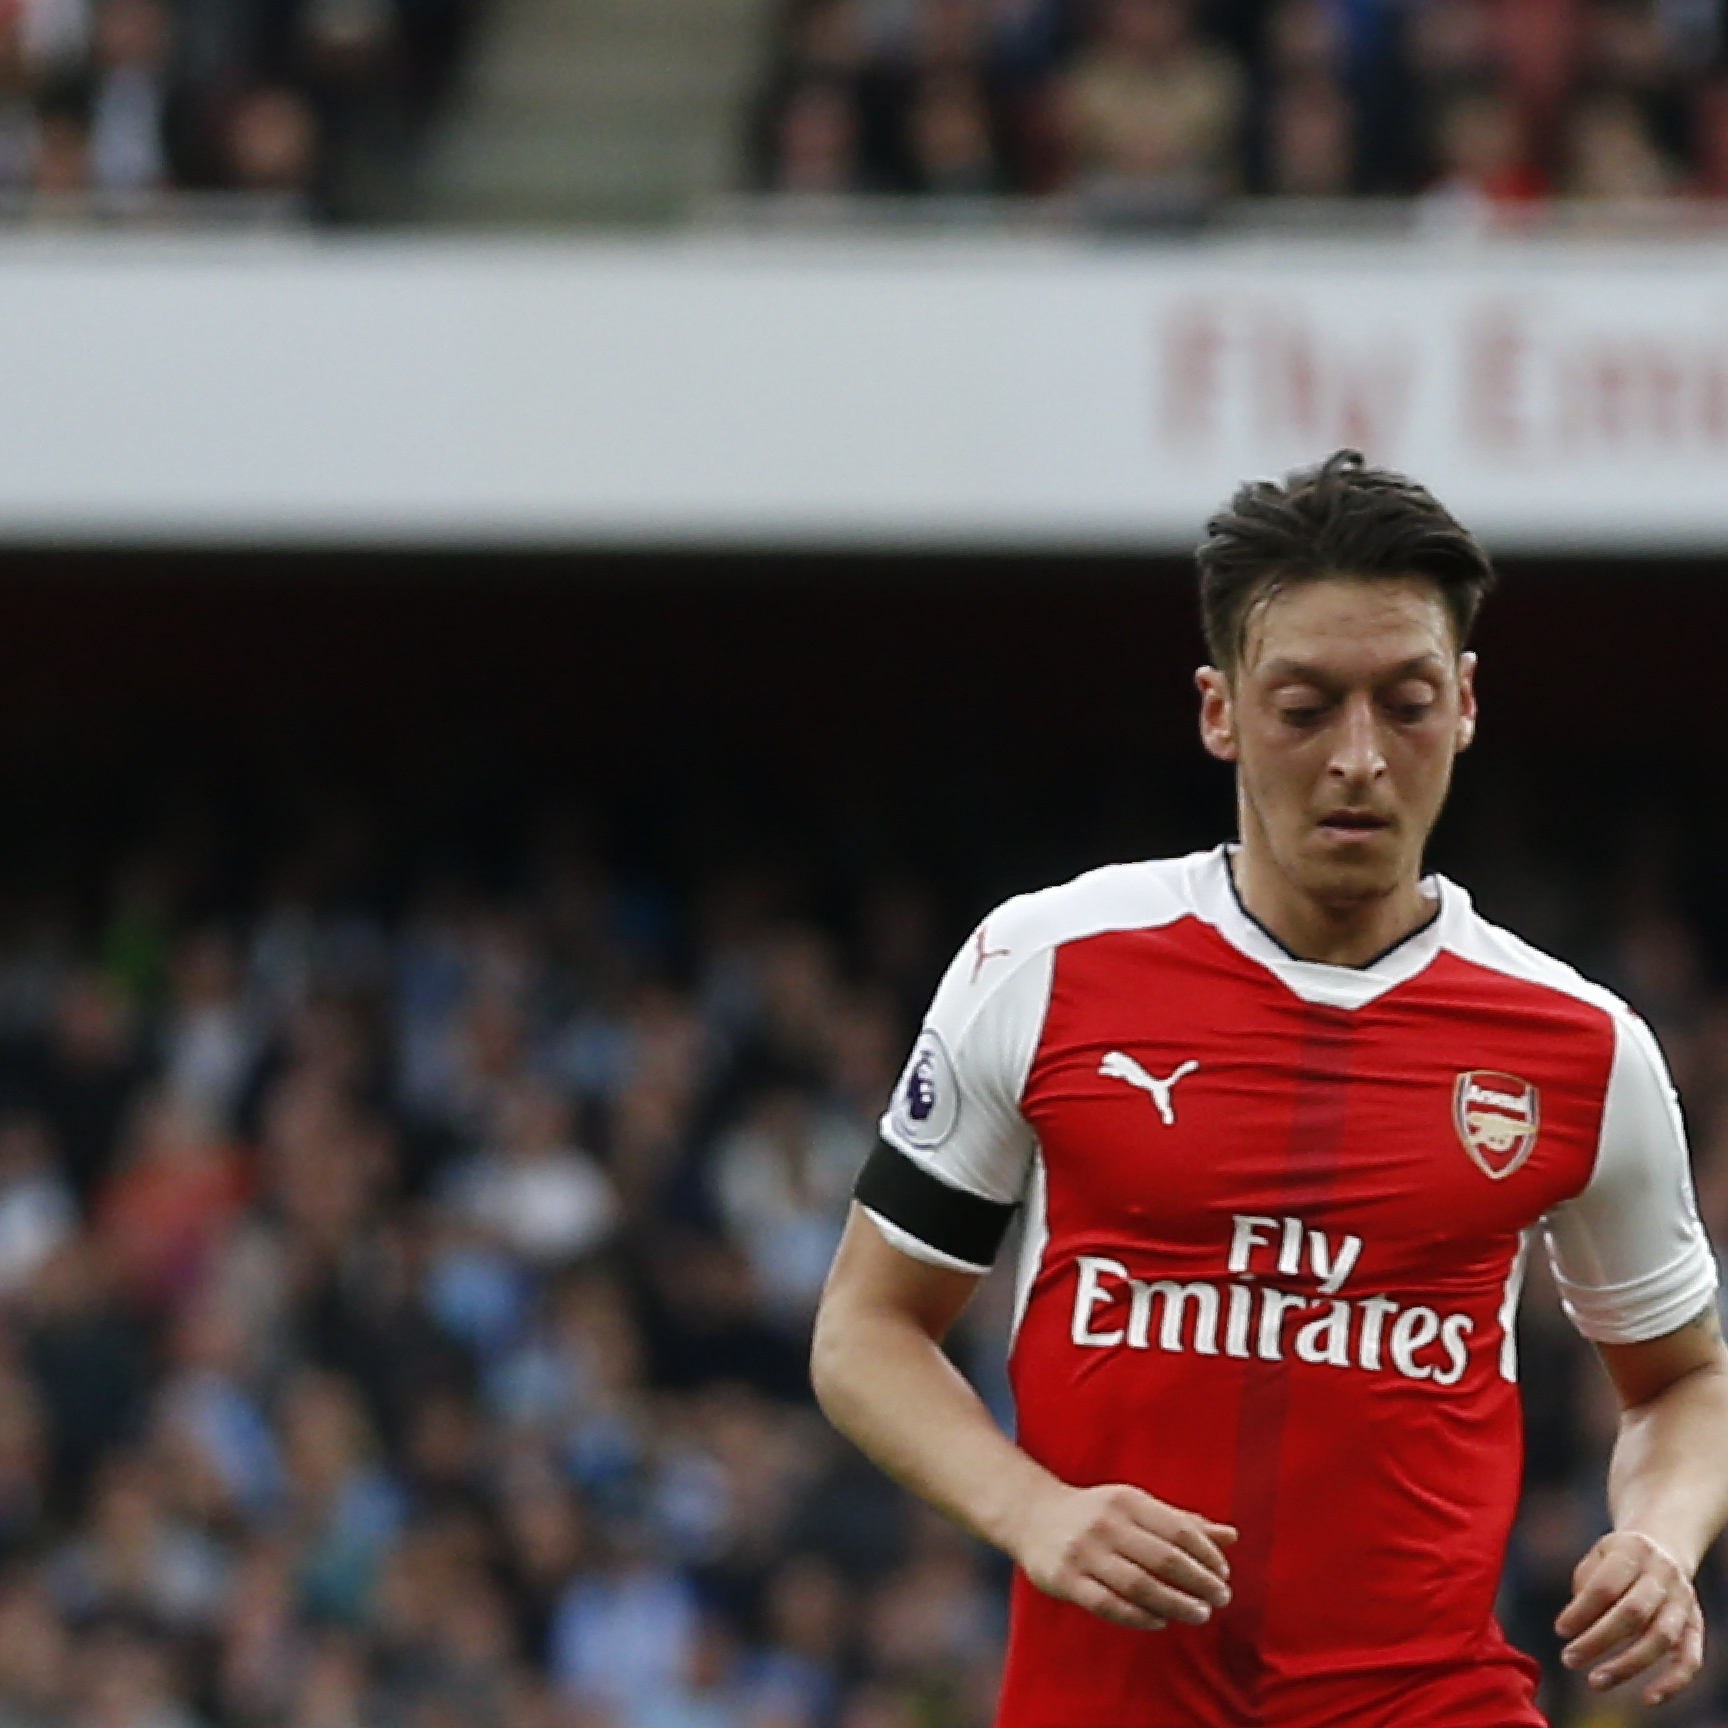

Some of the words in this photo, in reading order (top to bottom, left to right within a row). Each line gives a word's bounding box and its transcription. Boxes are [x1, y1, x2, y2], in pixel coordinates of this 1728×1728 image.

[1158, 294, 1402, 462] Fly
[1070, 1254, 1475, 1387] Emirates
[1227, 1214, 1363, 1294] Fly
